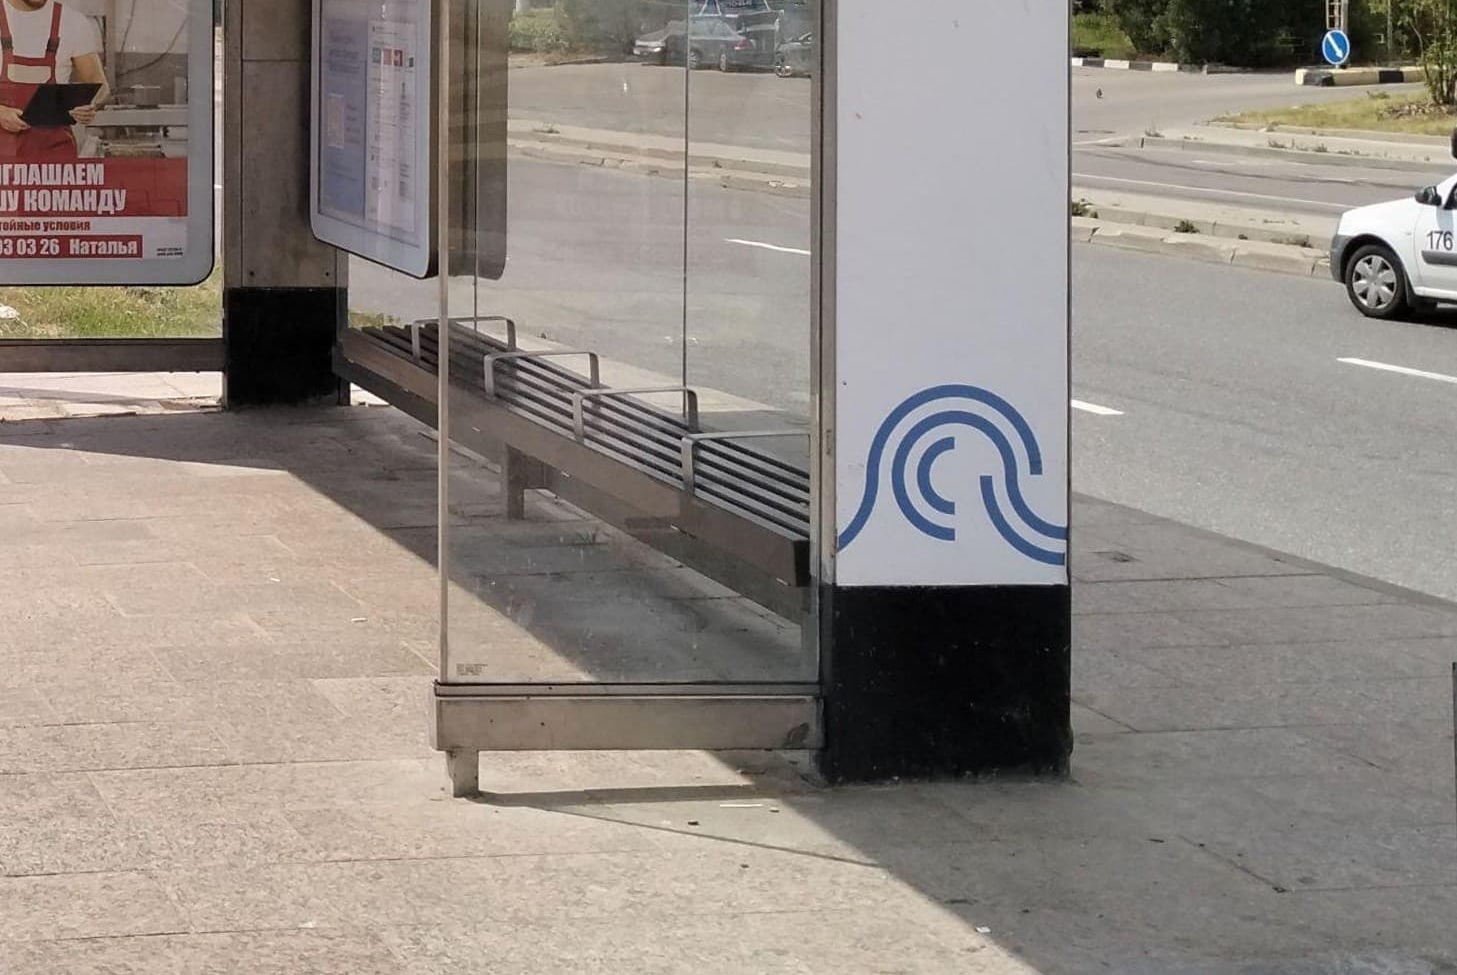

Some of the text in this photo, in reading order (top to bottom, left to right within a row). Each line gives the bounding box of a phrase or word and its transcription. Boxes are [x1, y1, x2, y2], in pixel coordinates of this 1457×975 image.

[24, 189, 127, 215] КОМАНДУ
[43, 221, 91, 232] условия
[16, 238, 37, 256] 03
[40, 238, 60, 255] 26
[69, 238, 138, 255] Наталья
[1426, 230, 1454, 251] 176
